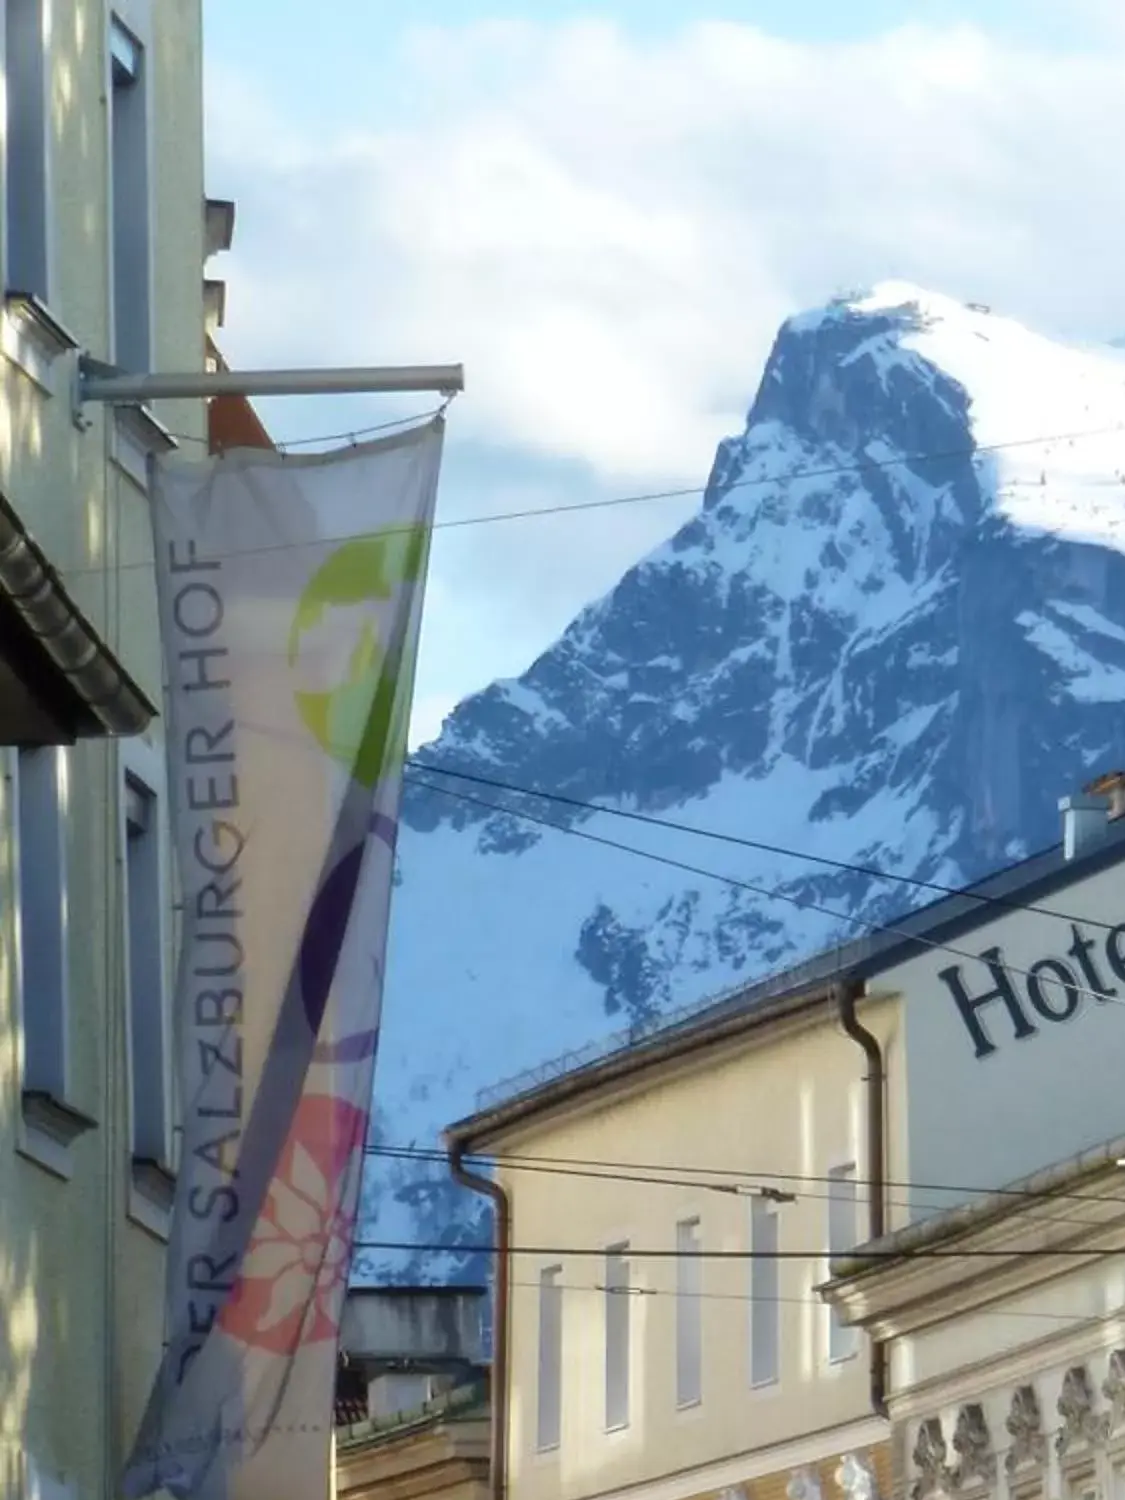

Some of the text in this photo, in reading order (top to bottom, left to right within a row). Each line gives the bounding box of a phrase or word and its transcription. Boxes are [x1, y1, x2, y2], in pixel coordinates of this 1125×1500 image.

[169, 536, 247, 1386] ER SALZBURGER HOF
